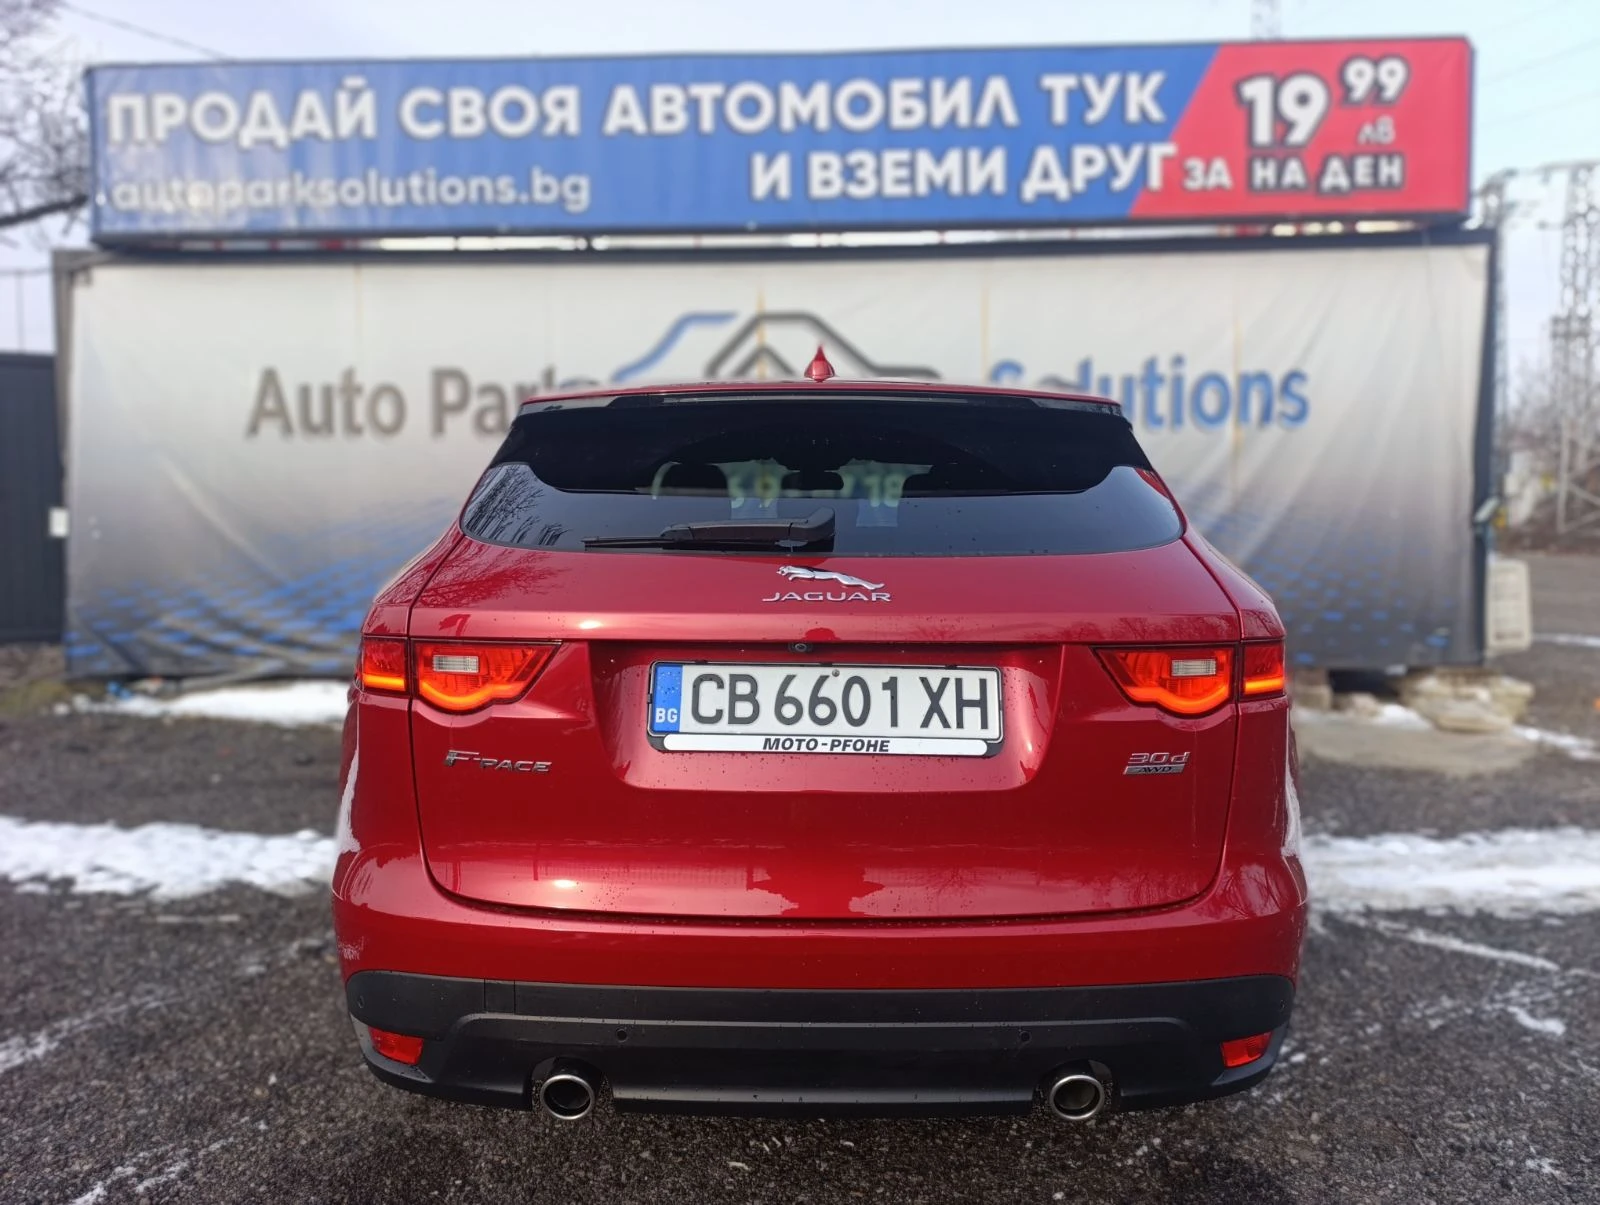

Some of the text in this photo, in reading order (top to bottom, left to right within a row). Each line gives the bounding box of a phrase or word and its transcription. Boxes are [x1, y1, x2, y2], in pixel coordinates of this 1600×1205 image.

[107, 70, 1167, 149] ПРОДАЙ СВОЯ АВТОМОБИЛ ТУК
[1237, 58, 1409, 147] 19 99
[113, 168, 591, 214] autoparksolutions.bg
[750, 143, 1233, 203] И ВЗЕМИ ДРУГ ЗА
[1251, 154, 1404, 193] НА ДЕН
[246, 367, 407, 440] Auto
[762, 591, 892, 602] JAGUAR
[655, 708, 678, 723] BG
[691, 673, 989, 730] CB 6601 XH
[444, 750, 552, 771] F-PACE
[762, 737, 890, 753] MOTO-PFOHE
[1128, 751, 1190, 763] 30d
